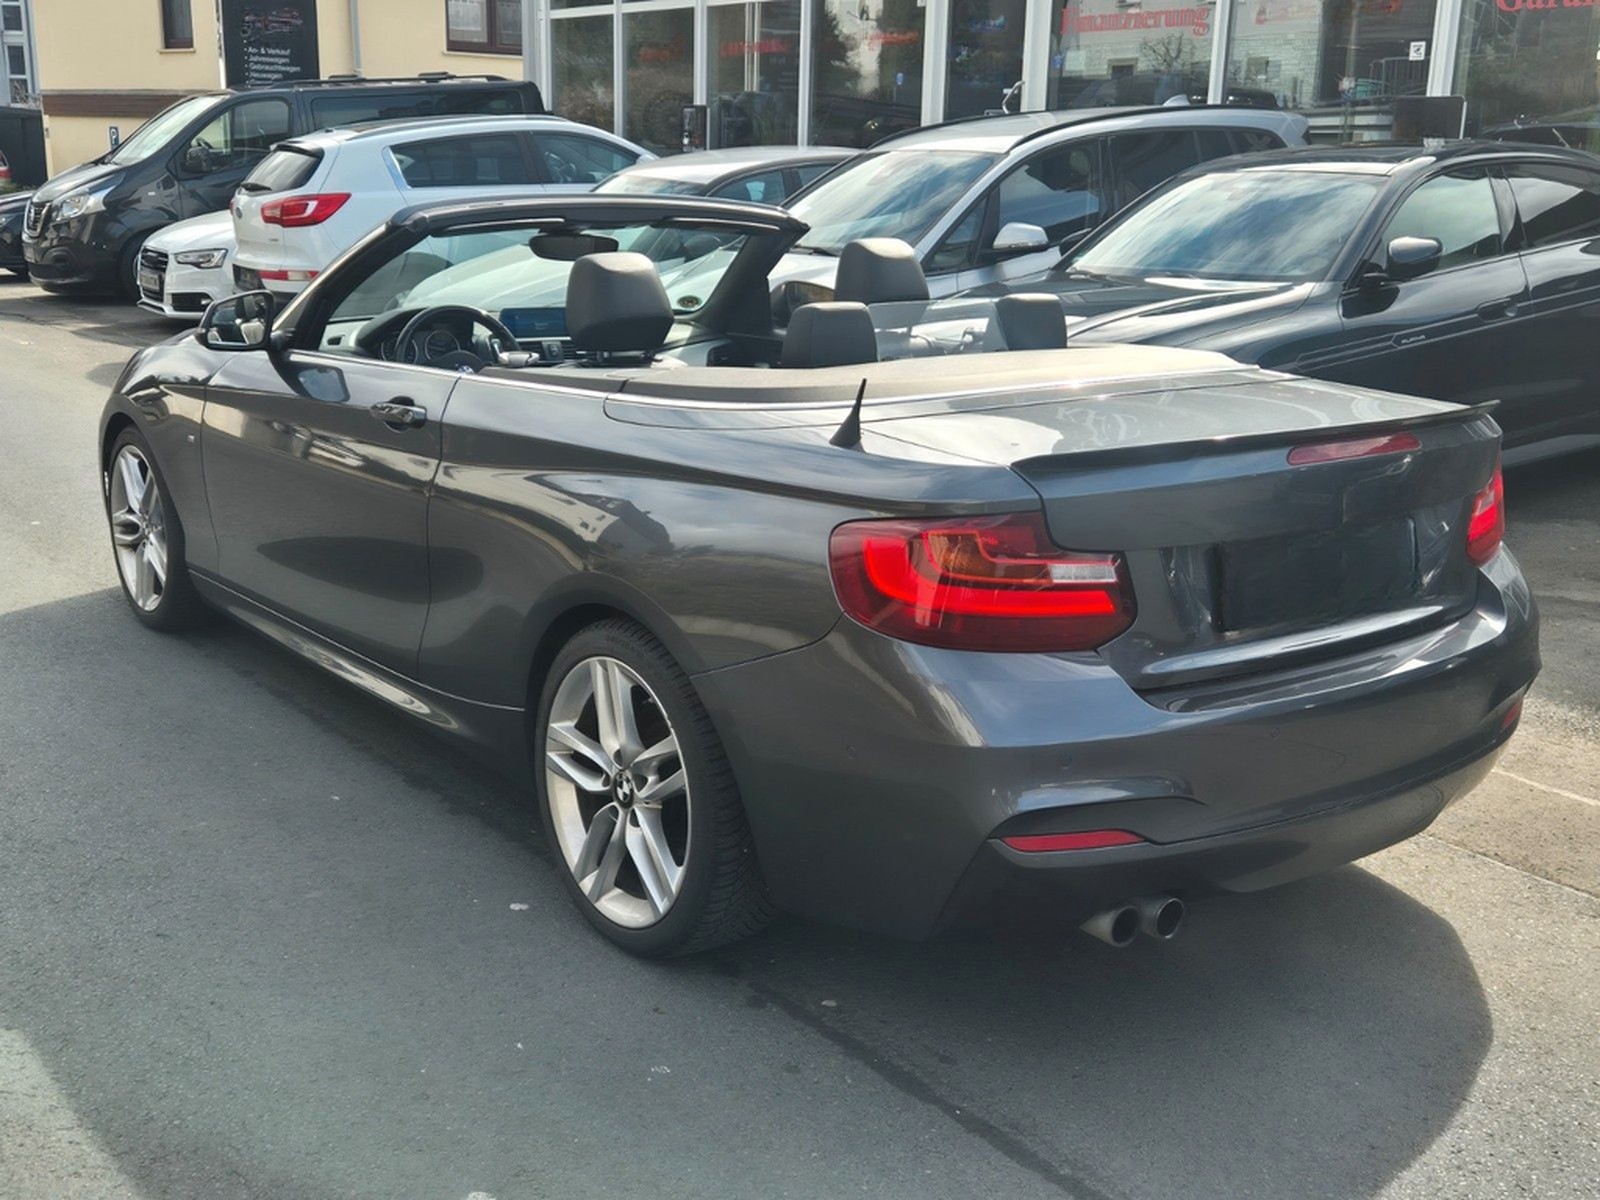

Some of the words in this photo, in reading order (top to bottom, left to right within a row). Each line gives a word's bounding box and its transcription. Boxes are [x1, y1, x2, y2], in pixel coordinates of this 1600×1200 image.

[1060, 8, 1210, 36] Finanzierung
[249, 54, 290, 64] Jahreswagen
[249, 62, 302, 73] Gebrauchtwagen
[250, 72, 284, 80] Neuwagen
